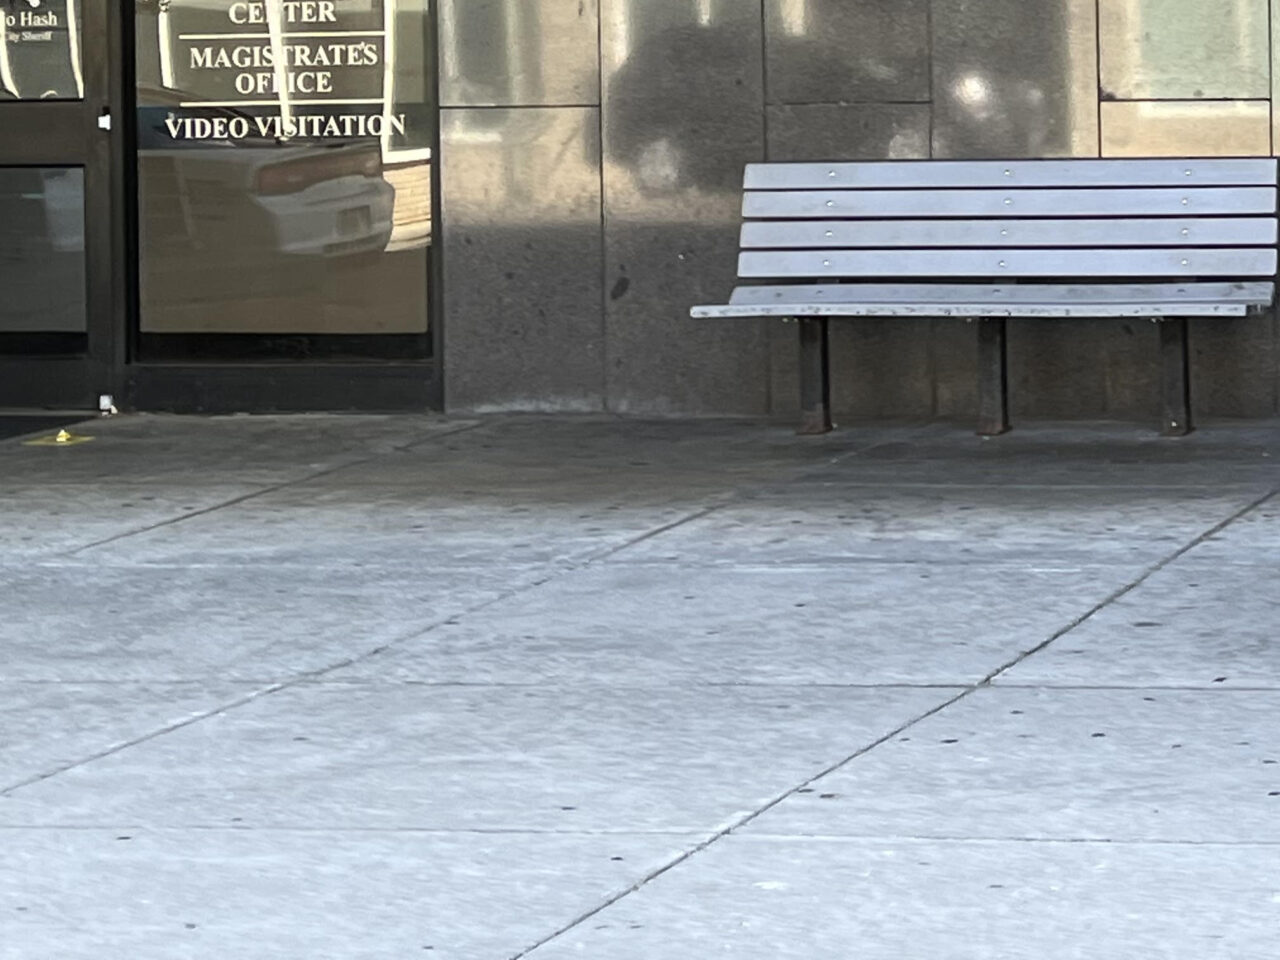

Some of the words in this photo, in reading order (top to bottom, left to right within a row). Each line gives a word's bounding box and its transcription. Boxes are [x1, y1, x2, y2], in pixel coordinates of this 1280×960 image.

[20, 10, 58, 27] Hash
[228, 1, 337, 24] CETER
[189, 41, 379, 69] MAGISTRATE'S
[165, 118, 249, 139] VIDEO
[254, 114, 405, 138] VISITATION
